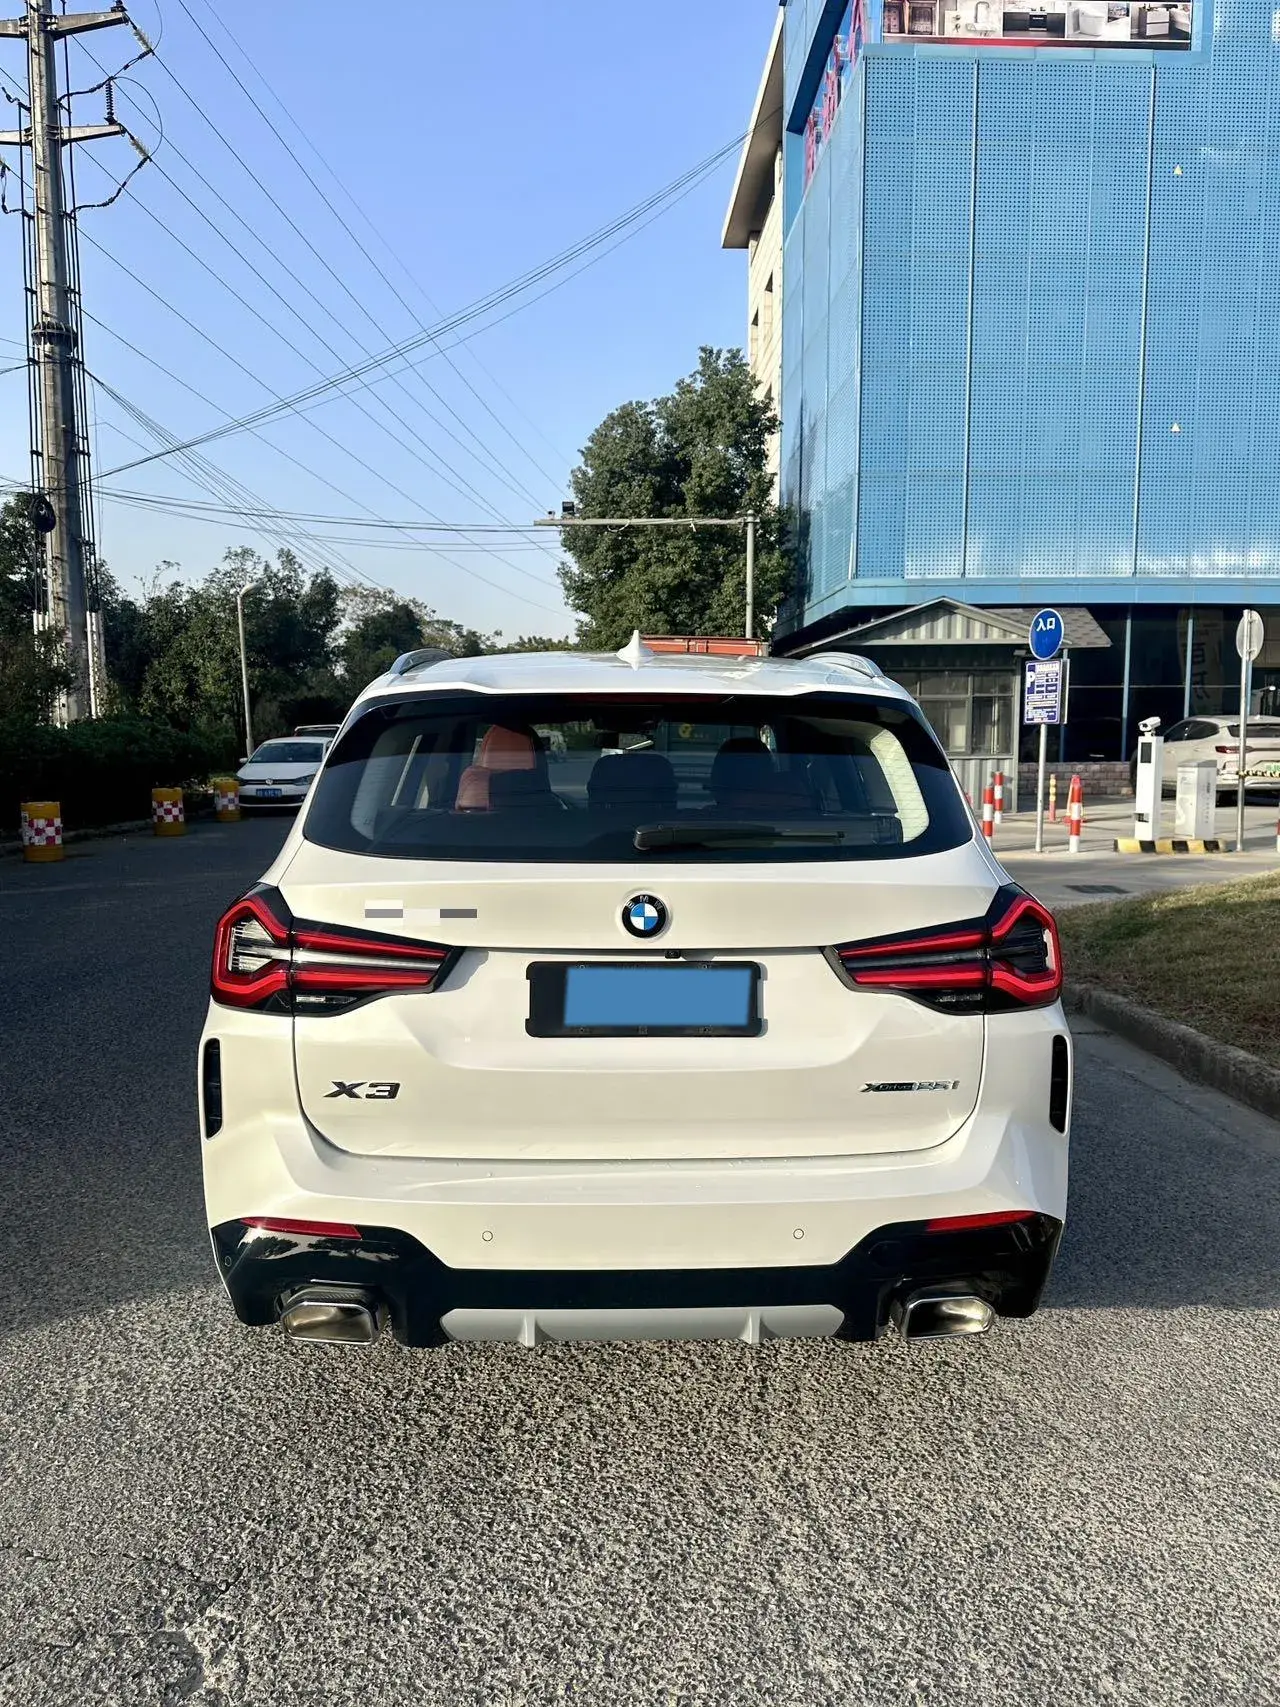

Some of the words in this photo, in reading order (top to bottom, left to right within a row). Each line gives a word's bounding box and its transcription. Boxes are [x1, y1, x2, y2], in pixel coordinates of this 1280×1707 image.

[1037, 617, 1055, 632] 入口
[1027, 671, 1036, 687] P
[626, 896, 663, 910] BMW
[323, 1081, 401, 1100] X3
